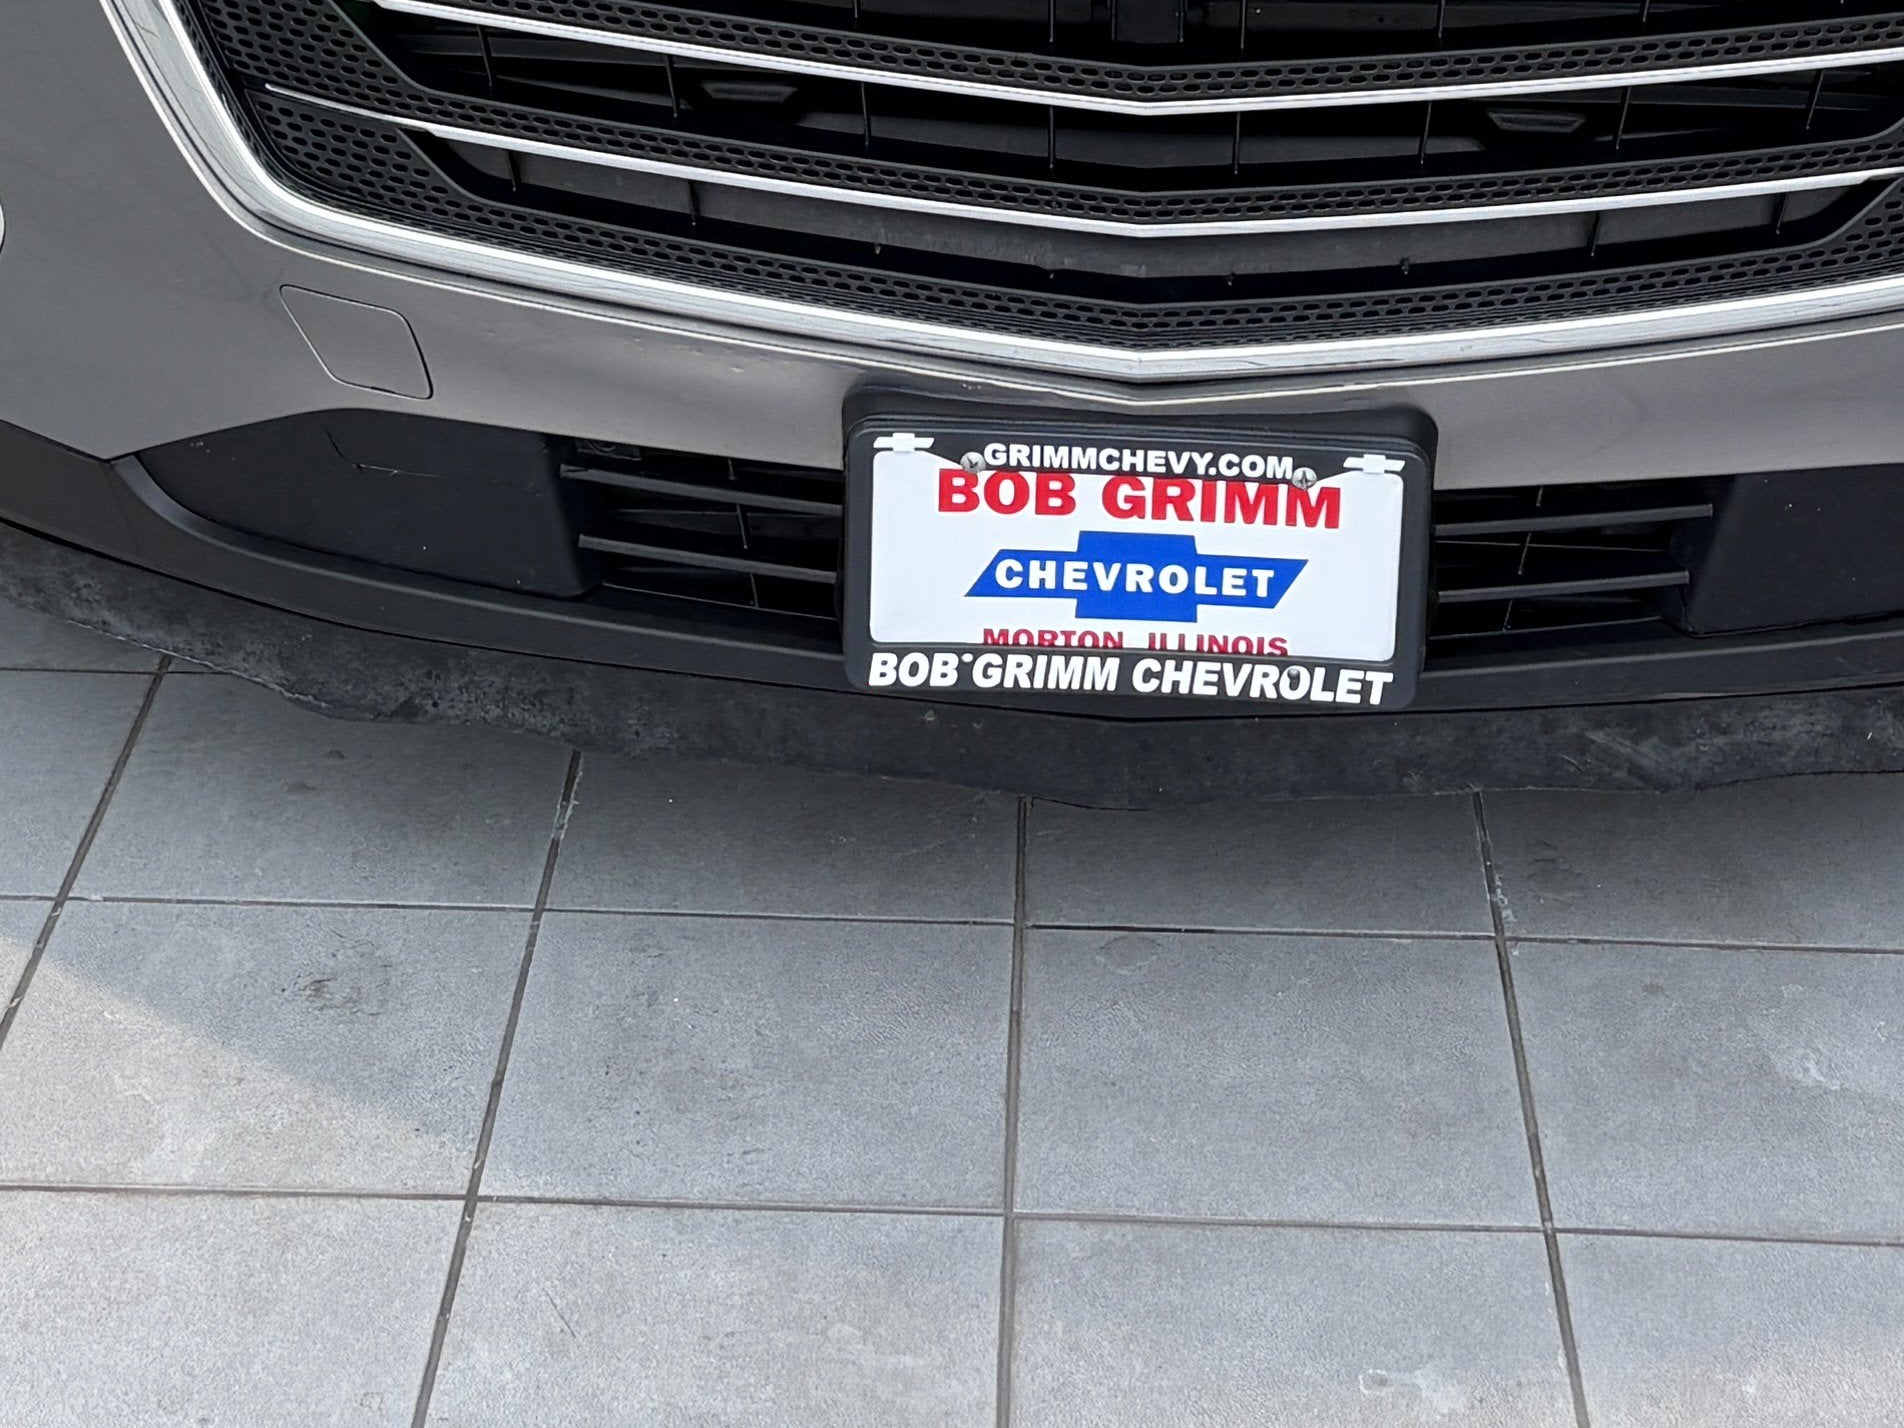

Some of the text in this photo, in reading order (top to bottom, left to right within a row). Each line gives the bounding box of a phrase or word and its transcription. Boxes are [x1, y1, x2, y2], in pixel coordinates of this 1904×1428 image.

[983, 442, 1294, 480] GRIMMCHEVY.COM
[937, 469, 1342, 530] BOB GRIMM
[995, 558, 1276, 599] CHEVROLET
[869, 652, 1394, 706] BOB GRIMM CHEVROLET
